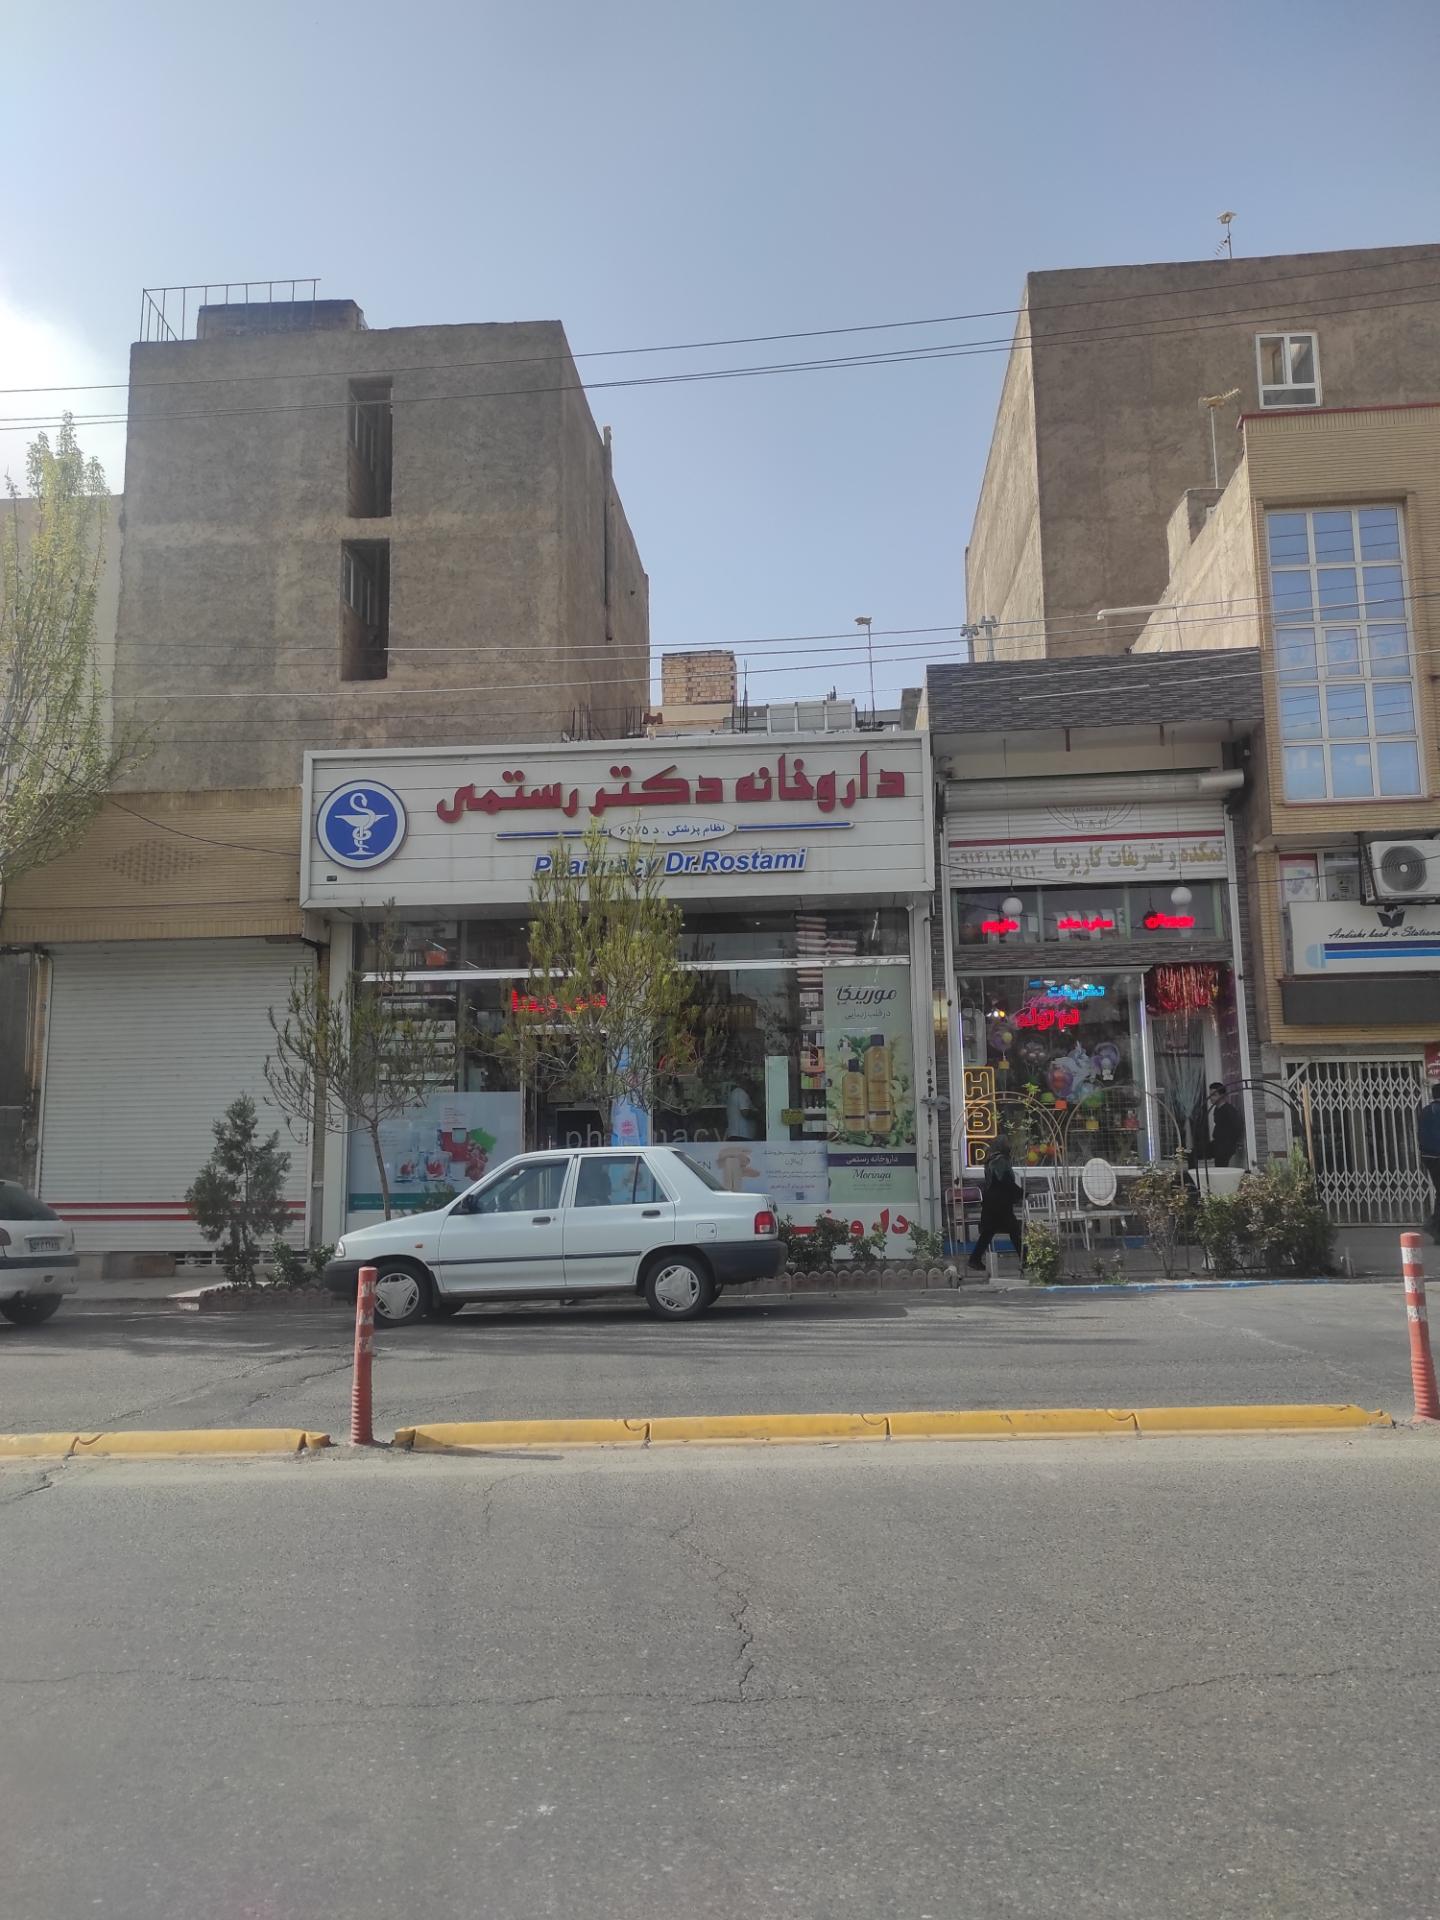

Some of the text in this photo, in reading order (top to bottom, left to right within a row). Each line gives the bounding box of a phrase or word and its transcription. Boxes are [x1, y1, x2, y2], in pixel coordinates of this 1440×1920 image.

[436, 750, 905, 824] داروخانه دکتر رستمی
[667, 824, 700, 837] پزشکی
[702, 823, 726, 836] نظام
[665, 847, 807, 875] Dr.Rostami
[1108, 842, 1165, 872] تشریفات
[870, 1154, 898, 1165] داروخانه
[853, 1168, 891, 1182] Moringa
